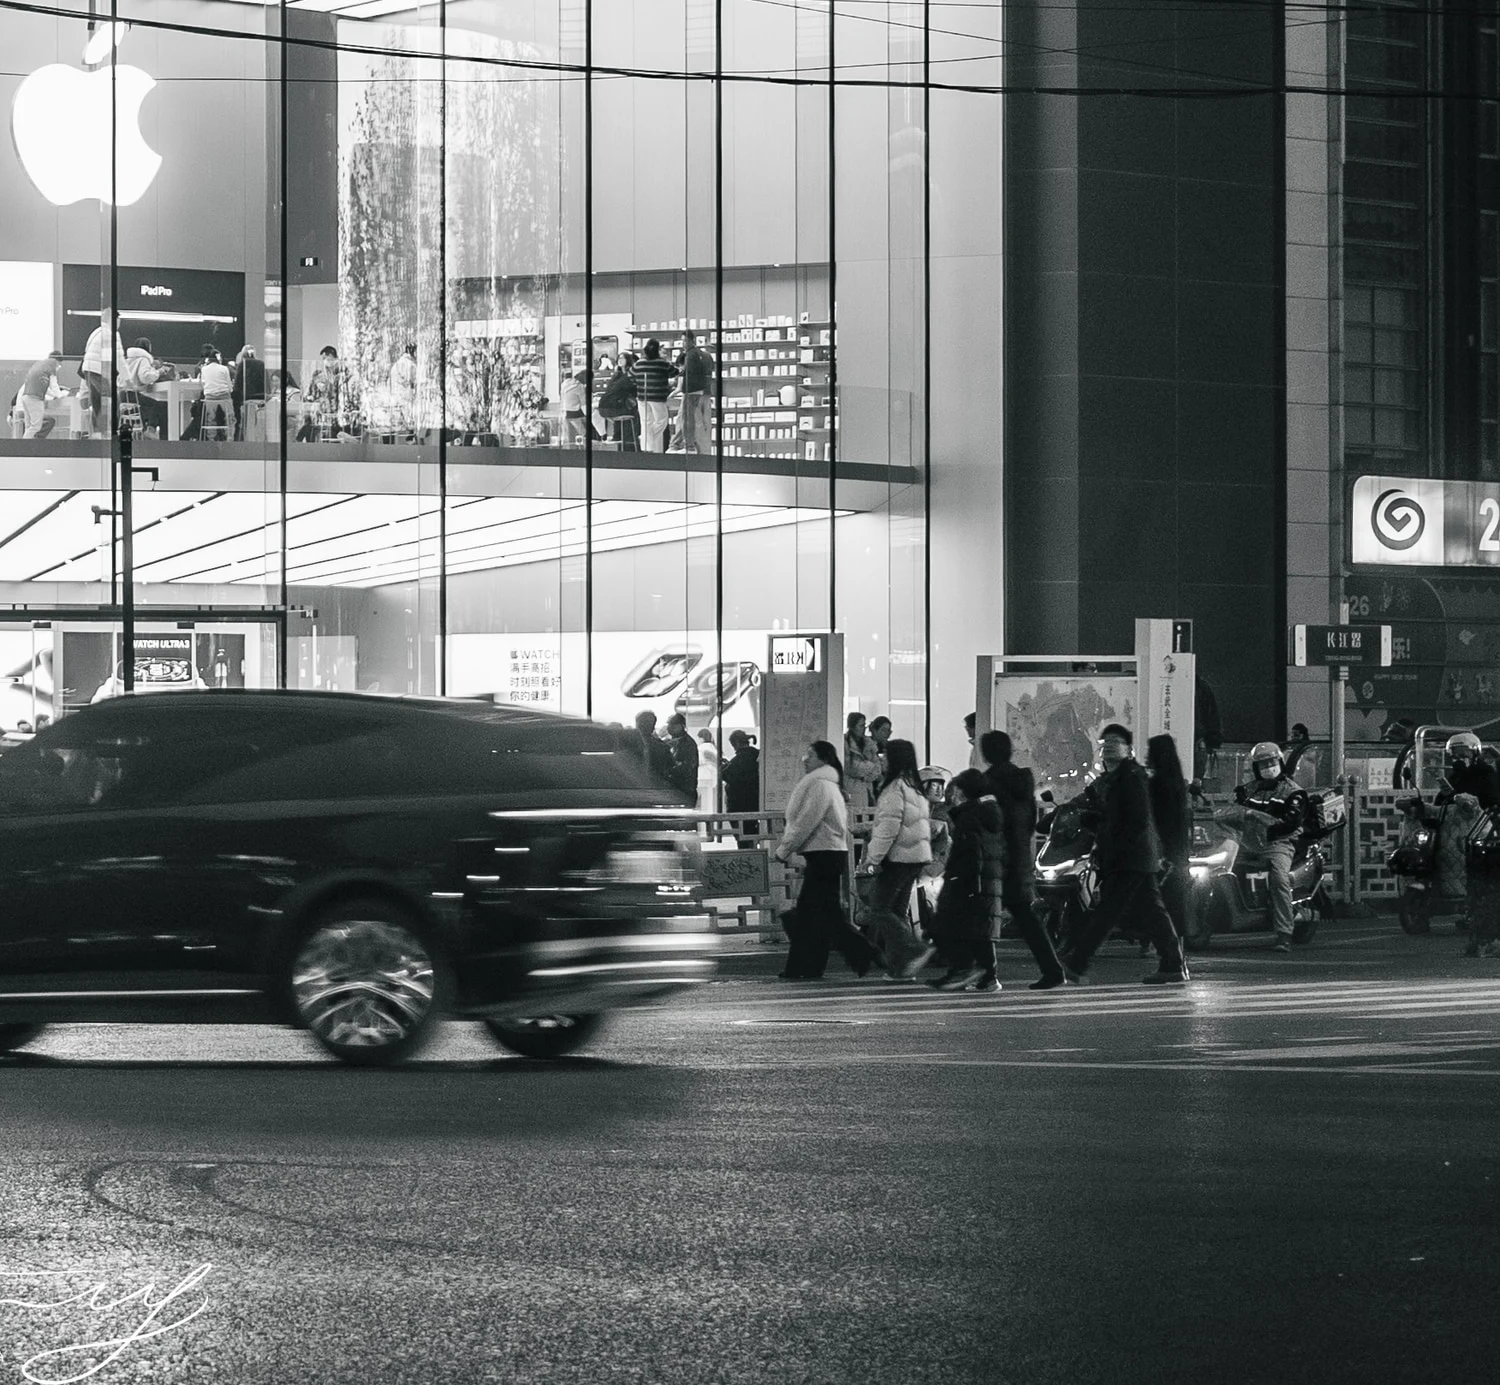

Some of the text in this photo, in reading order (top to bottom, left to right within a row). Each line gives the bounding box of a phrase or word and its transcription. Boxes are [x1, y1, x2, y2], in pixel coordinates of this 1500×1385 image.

[141, 285, 172, 296] iPad Pro
[5, 306, 19, 315] Pro
[1327, 632, 1362, 648] 长江路
[520, 649, 560, 659] WATCH
